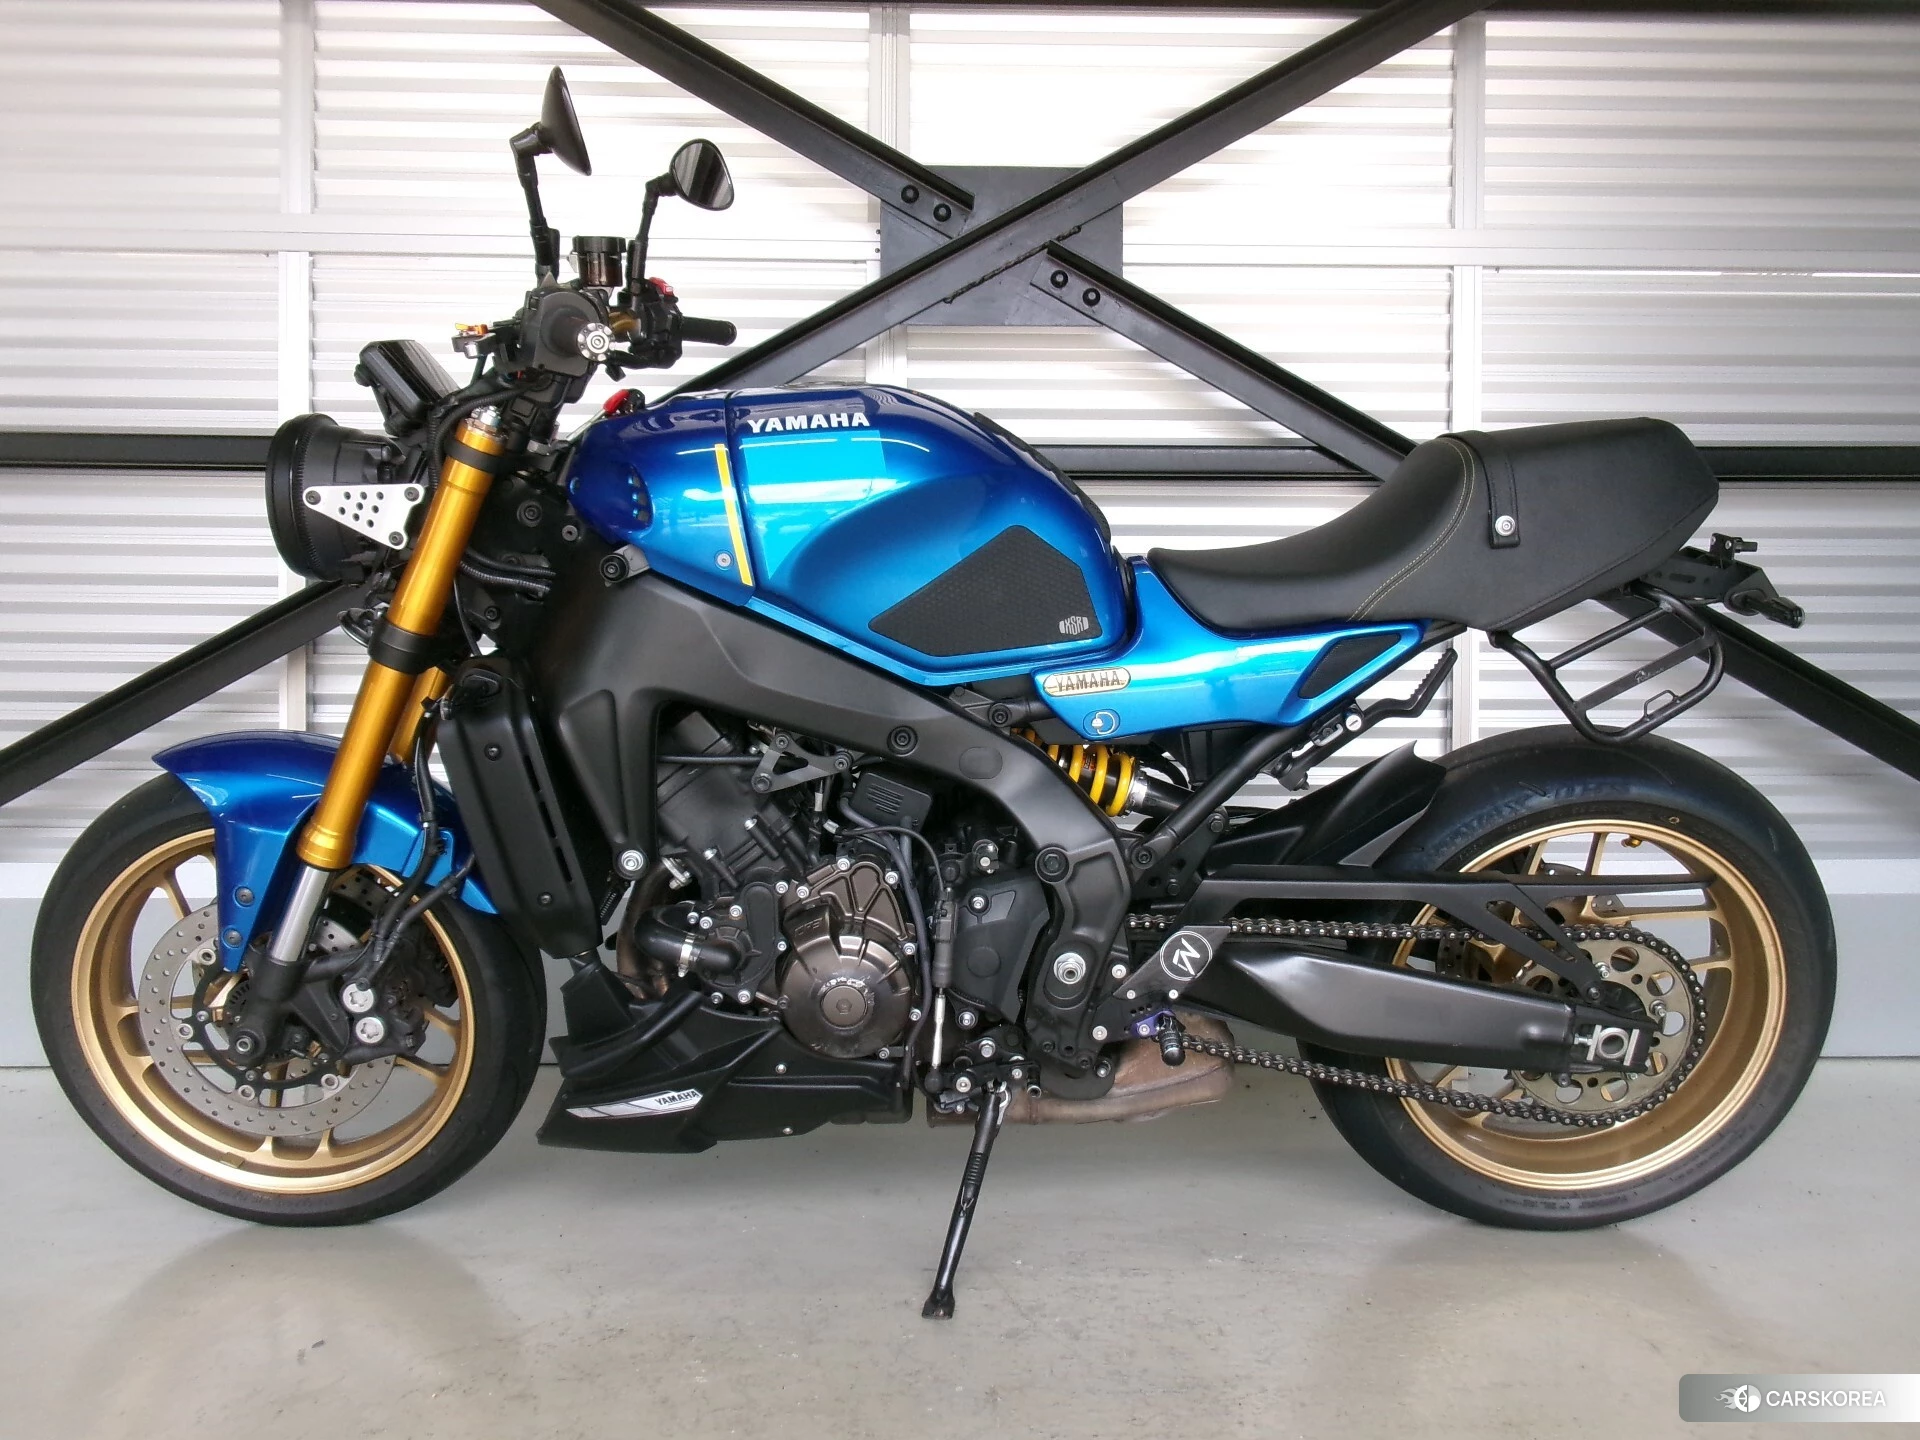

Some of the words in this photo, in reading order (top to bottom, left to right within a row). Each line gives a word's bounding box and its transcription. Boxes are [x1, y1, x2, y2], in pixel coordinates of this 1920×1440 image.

[747, 412, 870, 433] YAMAHA
[1064, 615, 1084, 636] XSR
[1056, 671, 1121, 692] YAMAHA
[654, 1090, 700, 1106] YAMAHA
